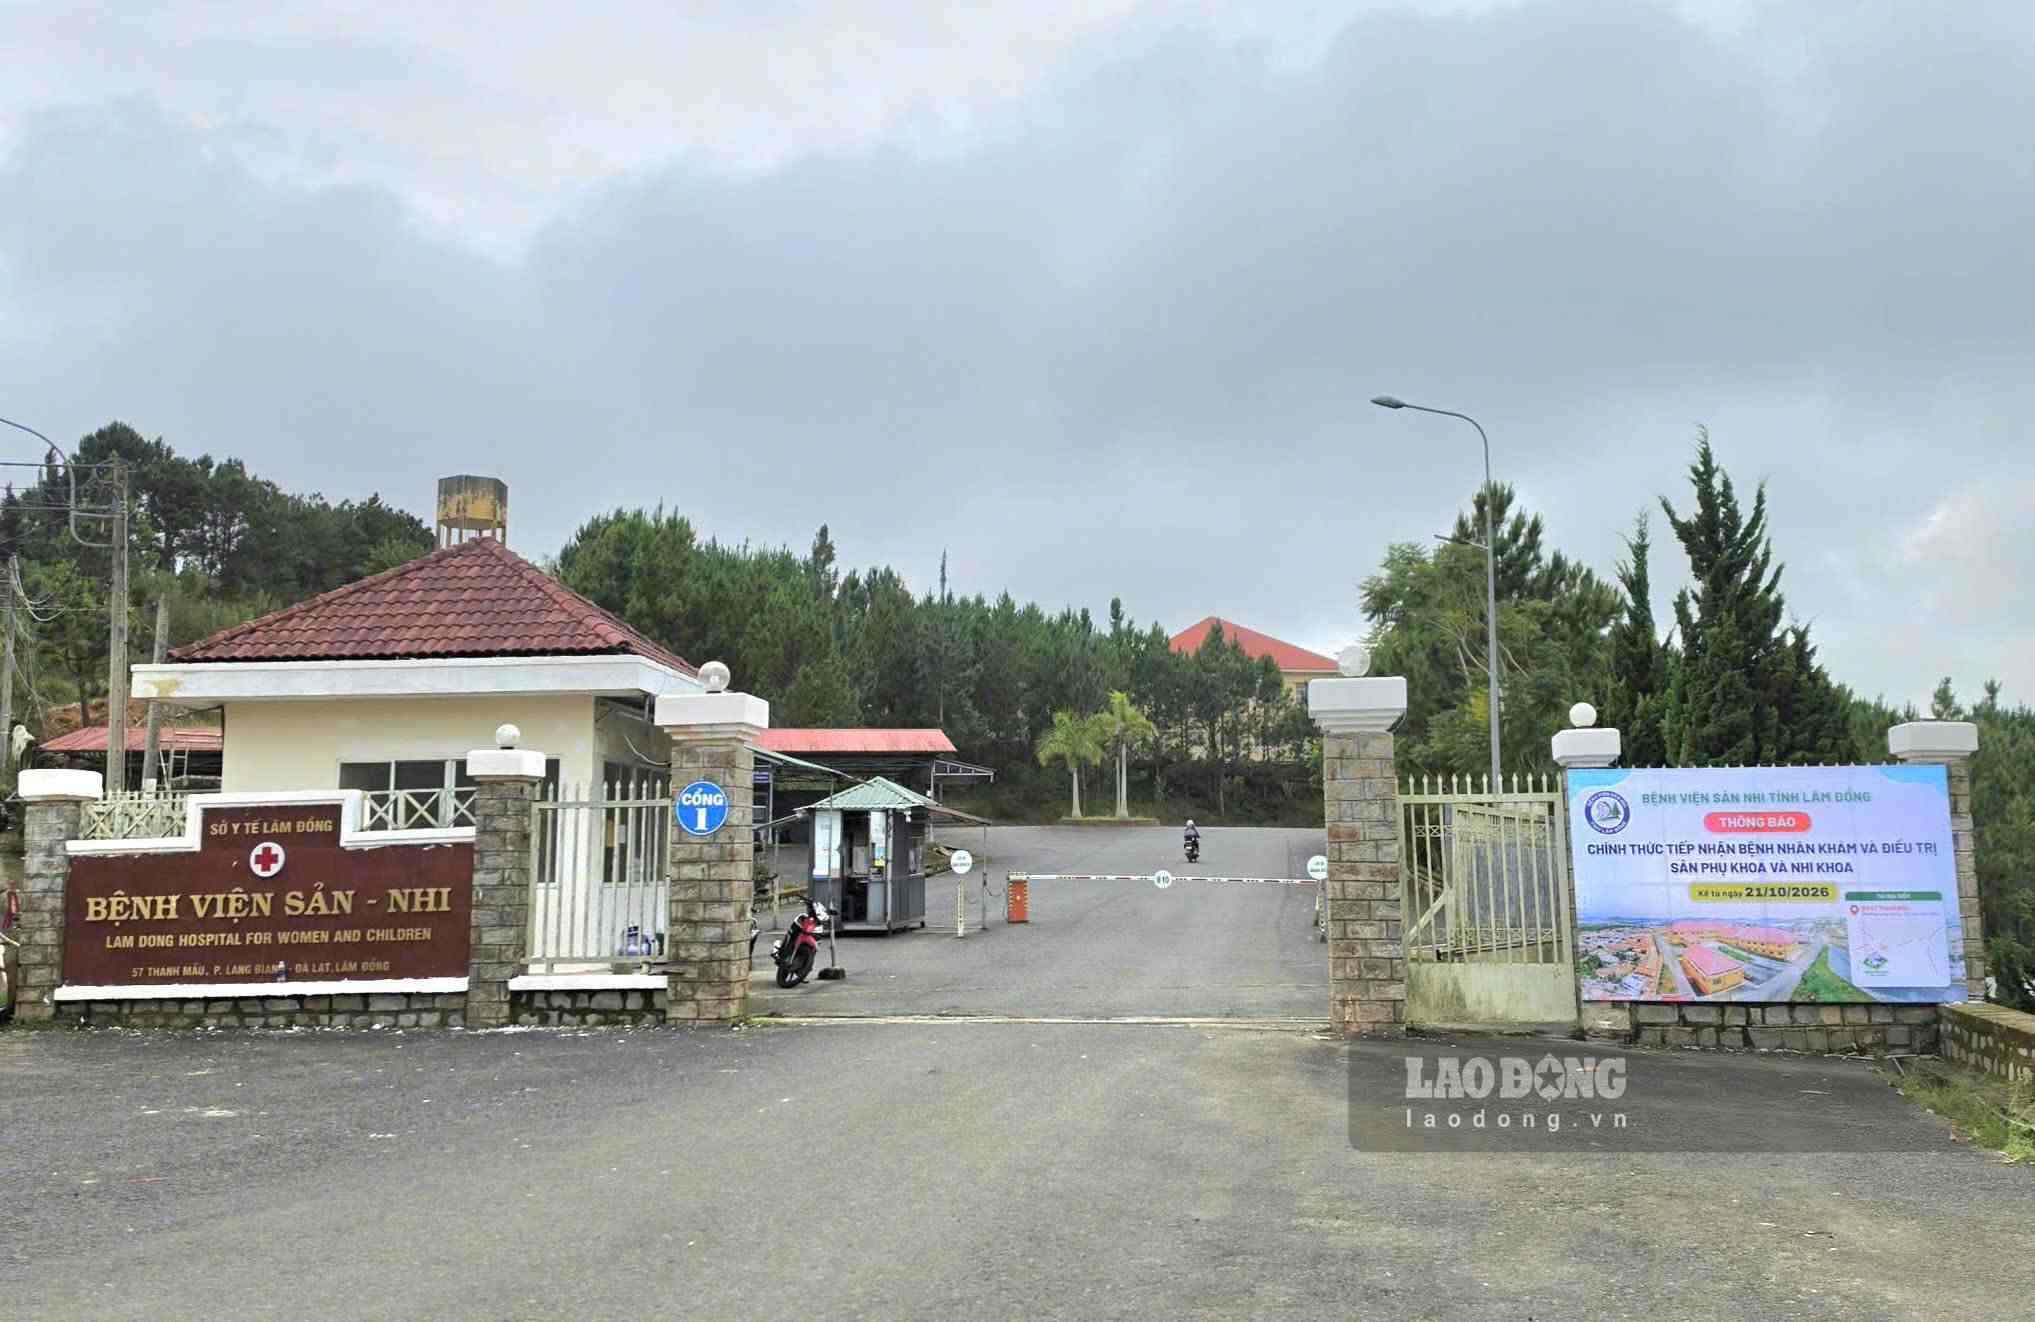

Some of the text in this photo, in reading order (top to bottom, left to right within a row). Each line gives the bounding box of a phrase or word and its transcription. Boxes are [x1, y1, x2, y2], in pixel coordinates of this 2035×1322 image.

[681, 787, 724, 806] CỔNG
[1743, 792, 1766, 803] NHI
[210, 816, 333, 837] SỞ Y TẾ LÂM ĐỒNG
[694, 807, 708, 831] 1
[1719, 813, 1765, 829] THÔNG
[1665, 840, 1696, 855] TIẾP
[1698, 841, 1736, 857] NHẬN
[1738, 841, 1774, 857] BỆNH
[1777, 841, 1815, 855] NHÂN
[1860, 840, 1877, 854] VÀ
[1916, 841, 1937, 857] TRỊ
[1701, 861, 1727, 876] PHỤ
[1731, 861, 1767, 873] KHOA
[1770, 859, 1788, 873] VÀ
[1791, 861, 1814, 873] NHI
[1817, 861, 1854, 873] KHOA
[85, 889, 180, 927] BỆNH
[189, 886, 275, 924] VIỆN
[284, 881, 356, 916] SẢN
[387, 887, 453, 914] NHI
[105, 927, 433, 949] LAM DONG HOSPITAL FOR WOMEN AND CHILDREN
[131, 967, 144, 978] 57
[213, 965, 222, 976] P.
[225, 963, 252, 975] LANG
[254, 962, 282, 975] BIAN
